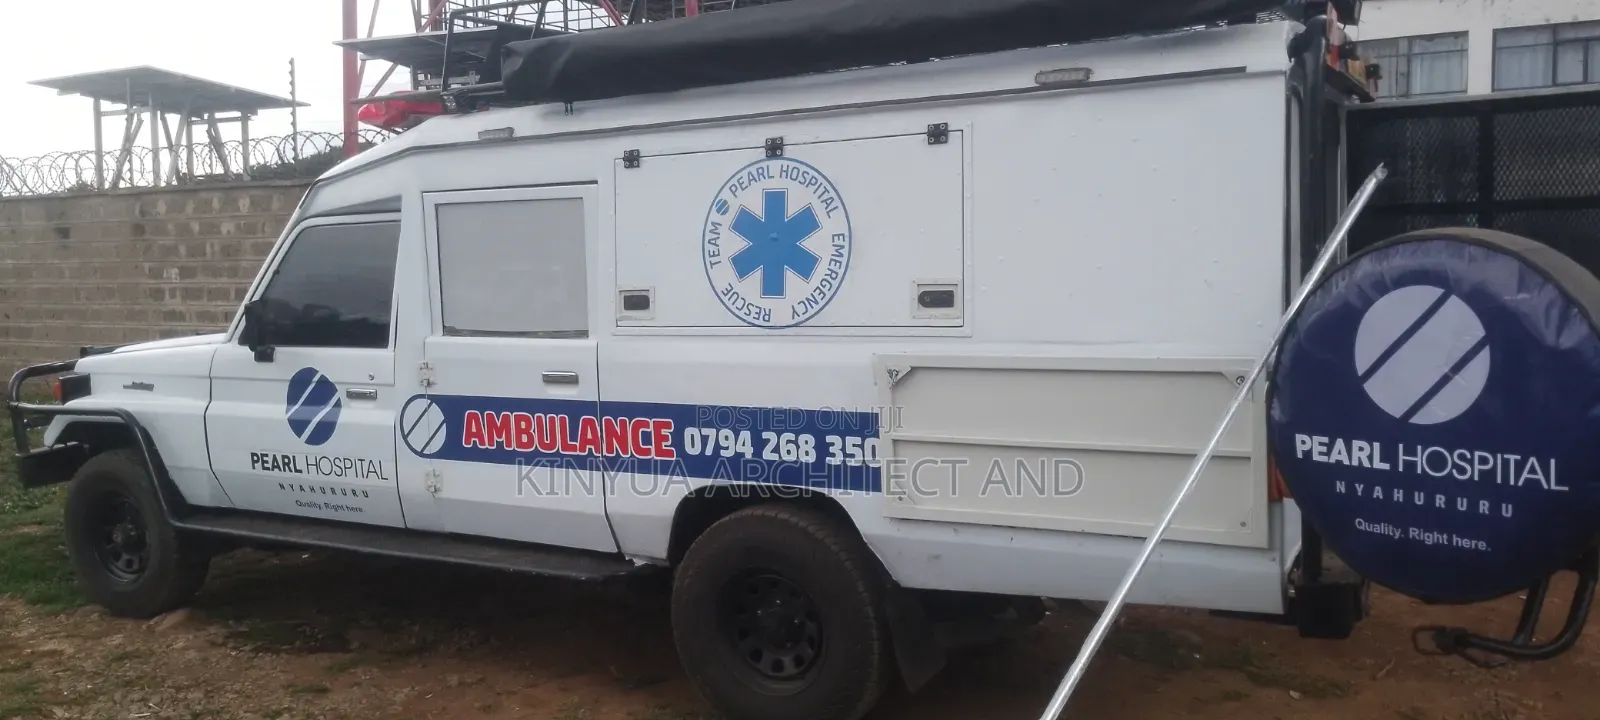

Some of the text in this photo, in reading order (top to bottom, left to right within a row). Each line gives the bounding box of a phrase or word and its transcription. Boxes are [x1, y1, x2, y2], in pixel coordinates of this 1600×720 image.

[707, 164, 846, 323] PEARL HOSPITAL EMERGENCY RESCUE TEAM
[462, 410, 676, 460] AMBULANCE
[684, 427, 882, 468] 0794 268 350
[250, 452, 389, 481] PEARL HOSPITAL
[1295, 433, 1569, 491] PEARL HOSPITAL
[278, 482, 369, 499] NYAHURURU
[295, 500, 367, 514] Quality. Right here.
[1335, 480, 1514, 518] NYAHURURU
[1354, 518, 1492, 552] Quality. Right here.
